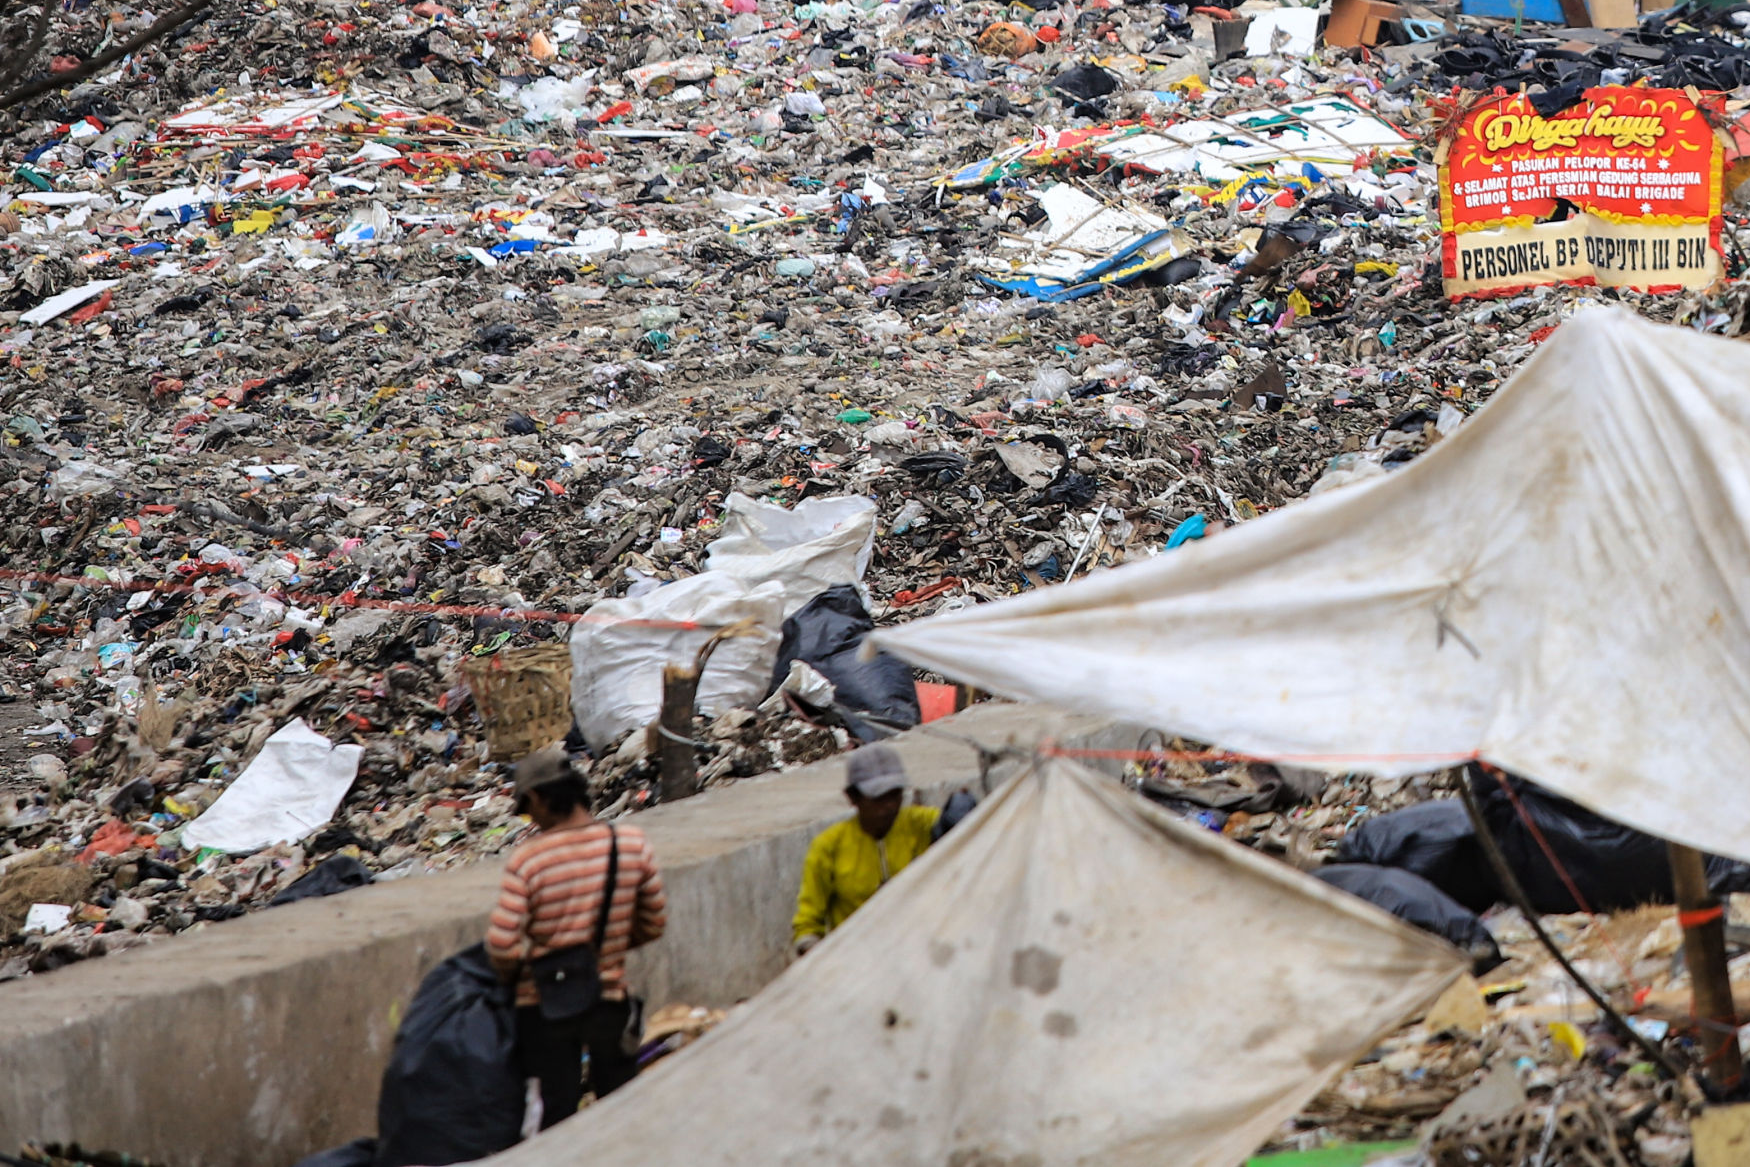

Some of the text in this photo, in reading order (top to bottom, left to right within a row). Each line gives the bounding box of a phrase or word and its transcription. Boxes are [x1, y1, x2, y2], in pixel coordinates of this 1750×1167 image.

[1485, 105, 1666, 151] Dirgahayu
[1512, 157, 1646, 173] PASUKAN PELOPOR KE-64
[1454, 171, 1701, 195] & SELAMAT ATAS PERESMIAN GEDUNG SERBAGUNA
[1465, 190, 1507, 207] BRIMOB
[1596, 185, 1630, 198] BALAI
[1635, 187, 1685, 199] BRIGADE
[1461, 241, 1550, 280] PERSONEL
[1584, 236, 1646, 270] DEPUTI
[1652, 239, 1669, 270] III
[1677, 237, 1706, 268] BIN
